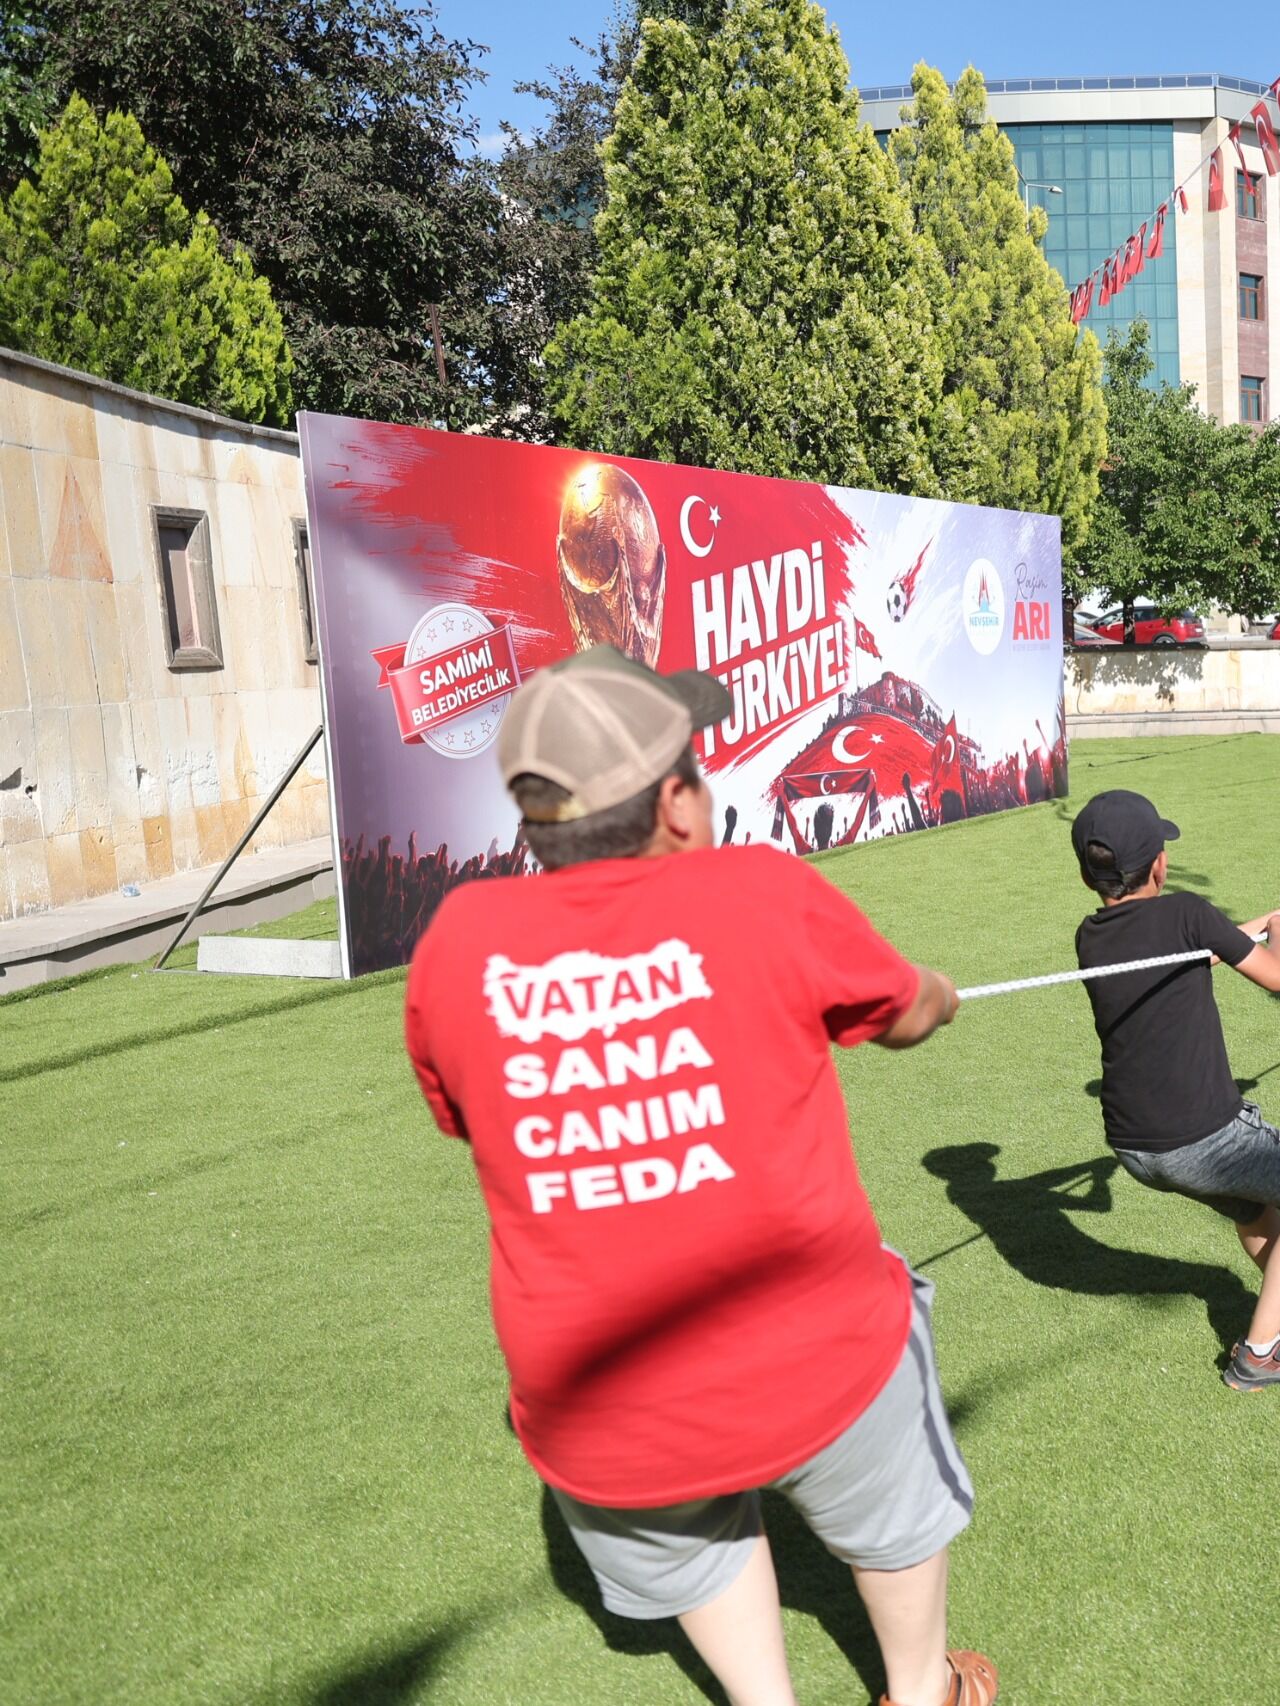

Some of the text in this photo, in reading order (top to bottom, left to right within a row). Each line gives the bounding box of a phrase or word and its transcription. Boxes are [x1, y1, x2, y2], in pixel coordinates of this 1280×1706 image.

[690, 540, 828, 671] HAYDİ
[1012, 601, 1051, 641] ARI
[410, 668, 512, 727] BELEDİYECİLİK
[418, 639, 495, 695] SAMİMİ
[502, 959, 684, 1021] VATAN
[502, 1026, 715, 1100] SANA
[512, 1082, 726, 1159] CANIM
[525, 1141, 737, 1214] FEDA
